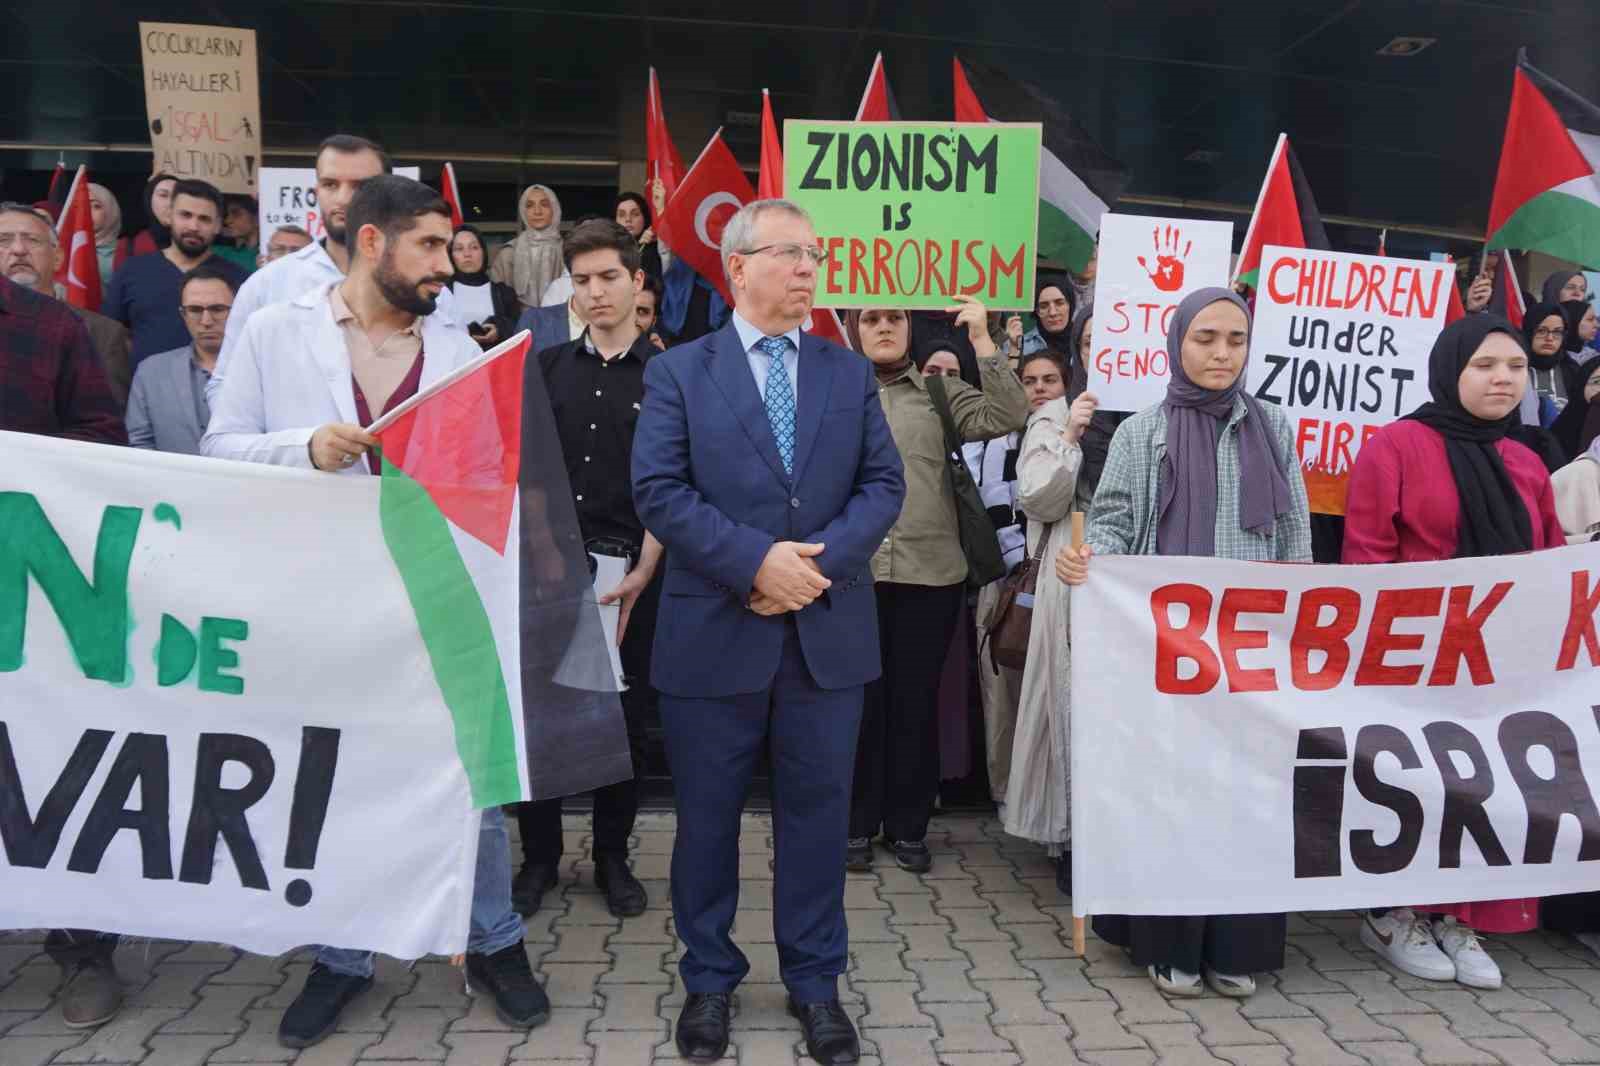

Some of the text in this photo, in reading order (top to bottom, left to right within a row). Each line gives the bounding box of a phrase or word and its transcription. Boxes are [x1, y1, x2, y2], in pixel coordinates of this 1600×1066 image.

[798, 131, 999, 194] ZIONISM
[280, 186, 318, 209] FRO
[882, 202, 912, 231] IS
[816, 236, 1026, 299] ERRORISM
[1267, 256, 1444, 319] CHILDREN
[1106, 301, 1178, 337] STO
[1095, 347, 1169, 385] GENO
[1255, 354, 1415, 417] ZIONIST
[0, 491, 249, 695] N'DE
[1150, 569, 1600, 695] BEBEK K
[0, 721, 342, 907] VAR!
[1293, 706, 1600, 879] İSRA
